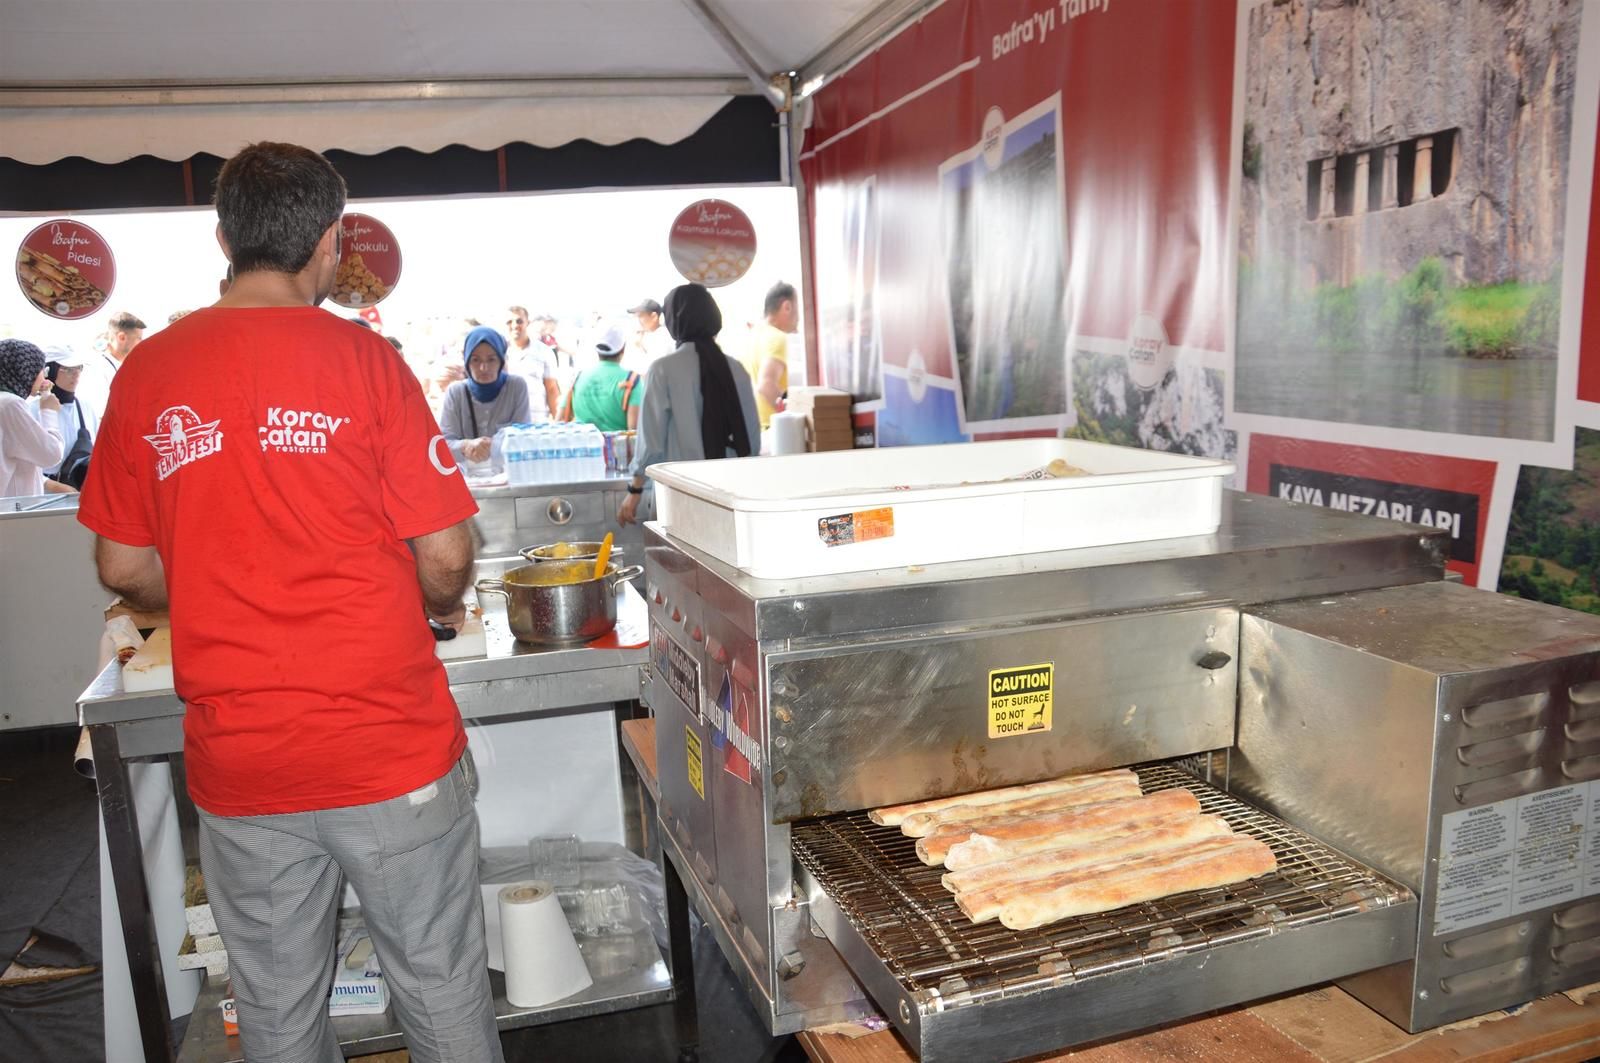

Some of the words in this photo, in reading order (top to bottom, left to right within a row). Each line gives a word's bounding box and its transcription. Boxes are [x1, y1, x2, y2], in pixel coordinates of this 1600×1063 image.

[51, 223, 91, 250] Bafra
[351, 242, 388, 252] Nokulu
[67, 252, 101, 266] Pidesi
[155, 429, 224, 480] TEKNOFEST
[276, 445, 327, 454] restoran
[1279, 482, 1323, 507] KAYA
[992, 671, 1049, 692] CAUTION
[991, 698, 1009, 709] HOT
[1011, 693, 1050, 706] SURFACE
[995, 711, 1007, 721] DO
[1009, 709, 1025, 720] NOT
[996, 722, 1024, 733] TOUCH
[335, 985, 377, 995] mumu
